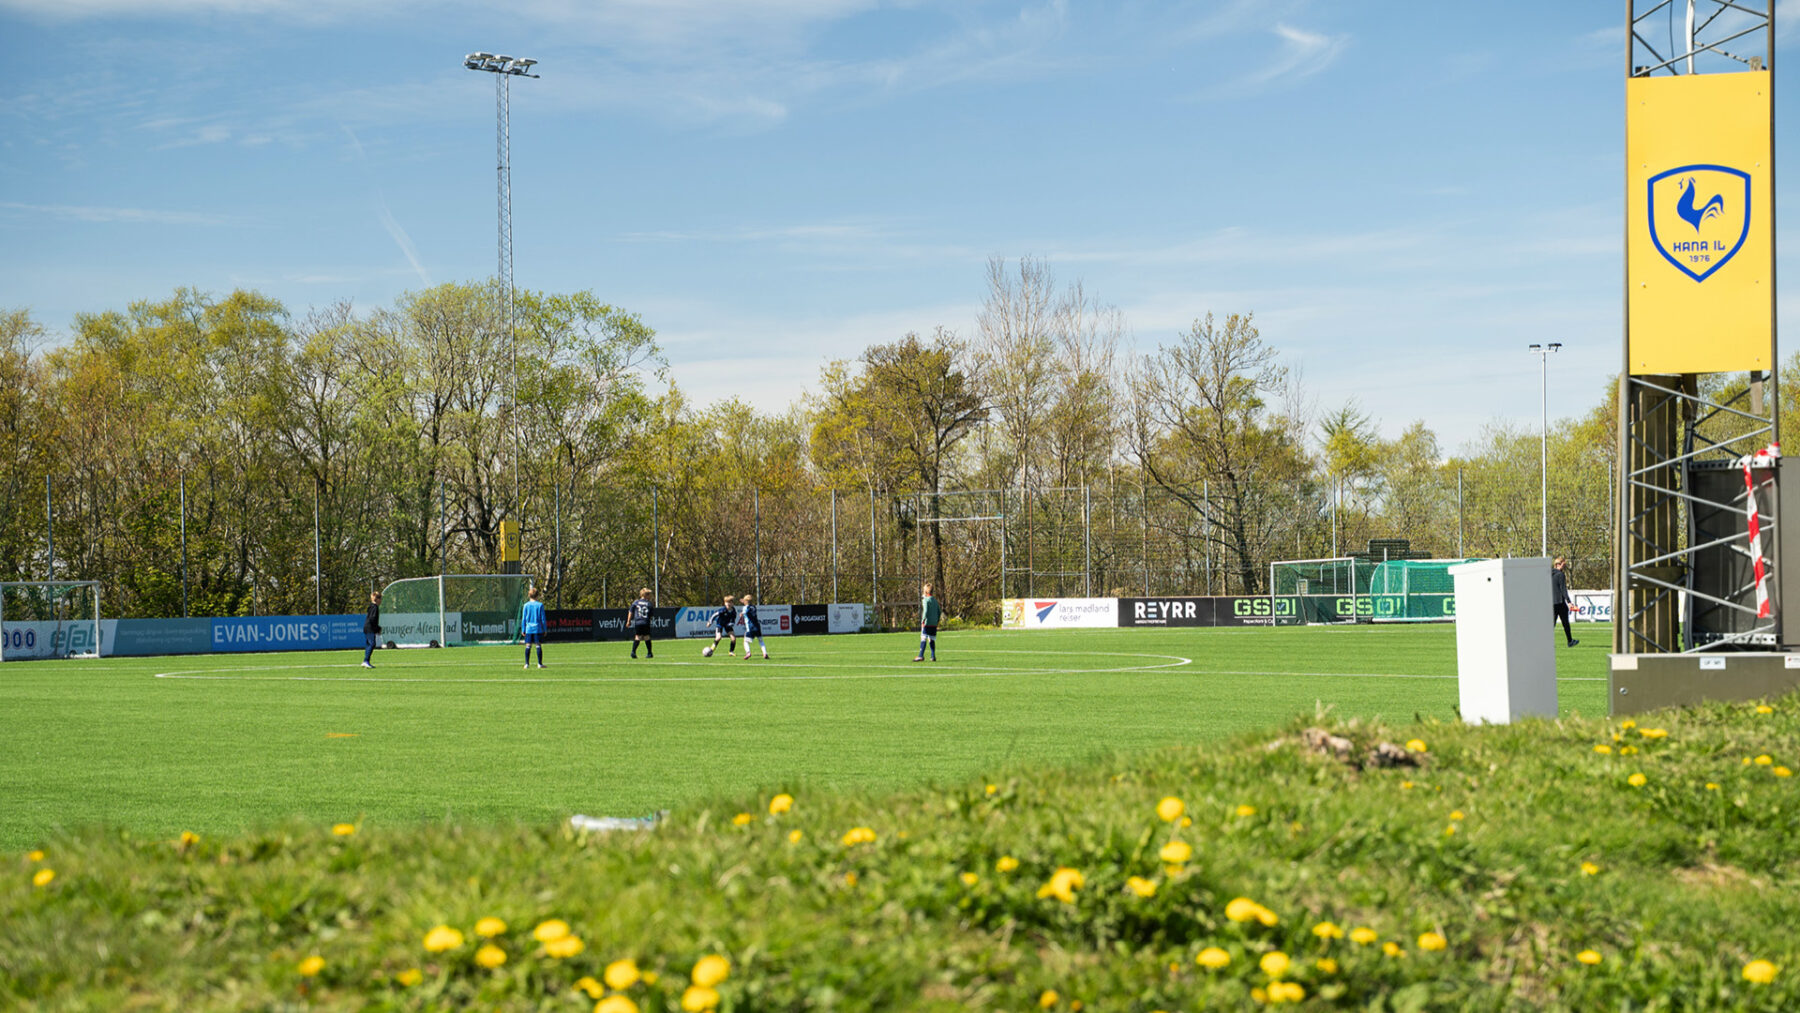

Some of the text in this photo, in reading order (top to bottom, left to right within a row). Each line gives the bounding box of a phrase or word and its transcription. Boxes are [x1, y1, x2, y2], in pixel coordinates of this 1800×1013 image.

[1673, 240, 1726, 252] HANA IL
[1689, 255, 1710, 263] 1976
[1059, 603, 1110, 613] lars madland
[1134, 601, 1197, 618] REYRR
[1059, 613, 1081, 622] reiser
[416, 620, 457, 636] Aftenlad
[469, 620, 506, 634] hummel
